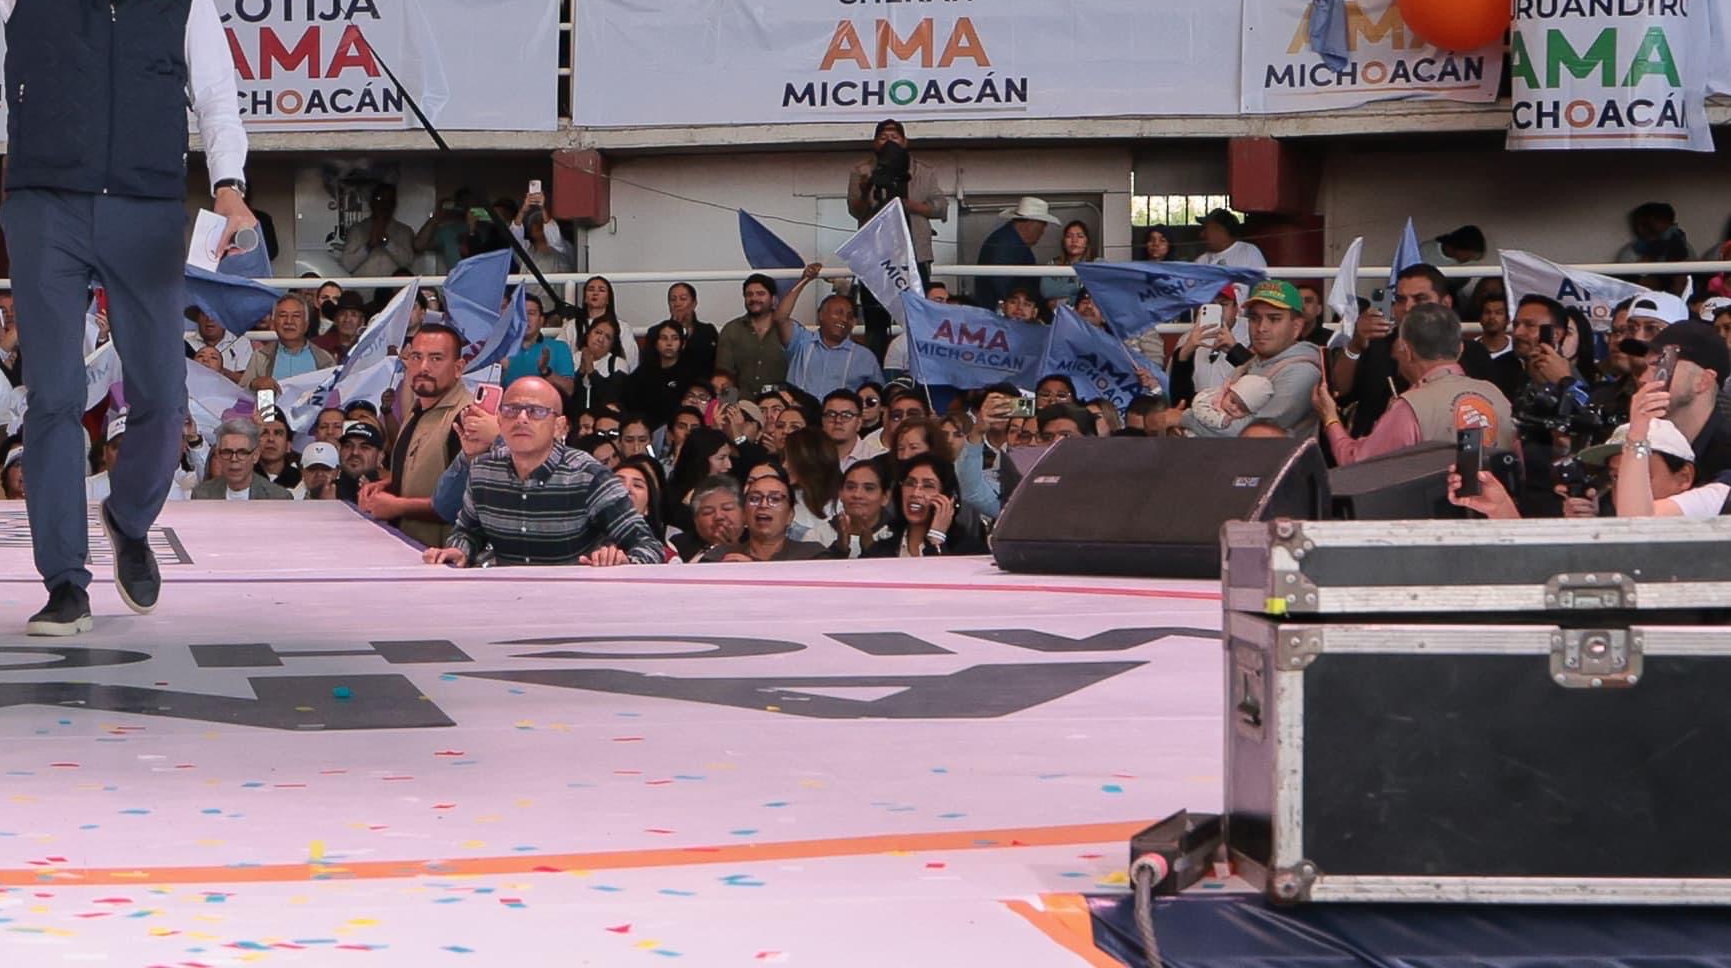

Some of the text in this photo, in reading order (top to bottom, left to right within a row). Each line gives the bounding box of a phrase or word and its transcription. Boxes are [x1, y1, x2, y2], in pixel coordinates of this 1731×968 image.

[819, 16, 991, 71] AMA
[1513, 26, 1682, 90] AMA
[1264, 51, 1484, 90] MICHOACÁN
[236, 83, 404, 117] CHOACÁN
[781, 72, 1028, 108] MICHOACÁN
[1514, 93, 1688, 130] CHOACÁ
[932, 319, 1009, 353] AMA
[916, 341, 1025, 371] MICHOACAN
[1057, 360, 1127, 416] MICHOAC
[1078, 354, 1142, 398] AMA
